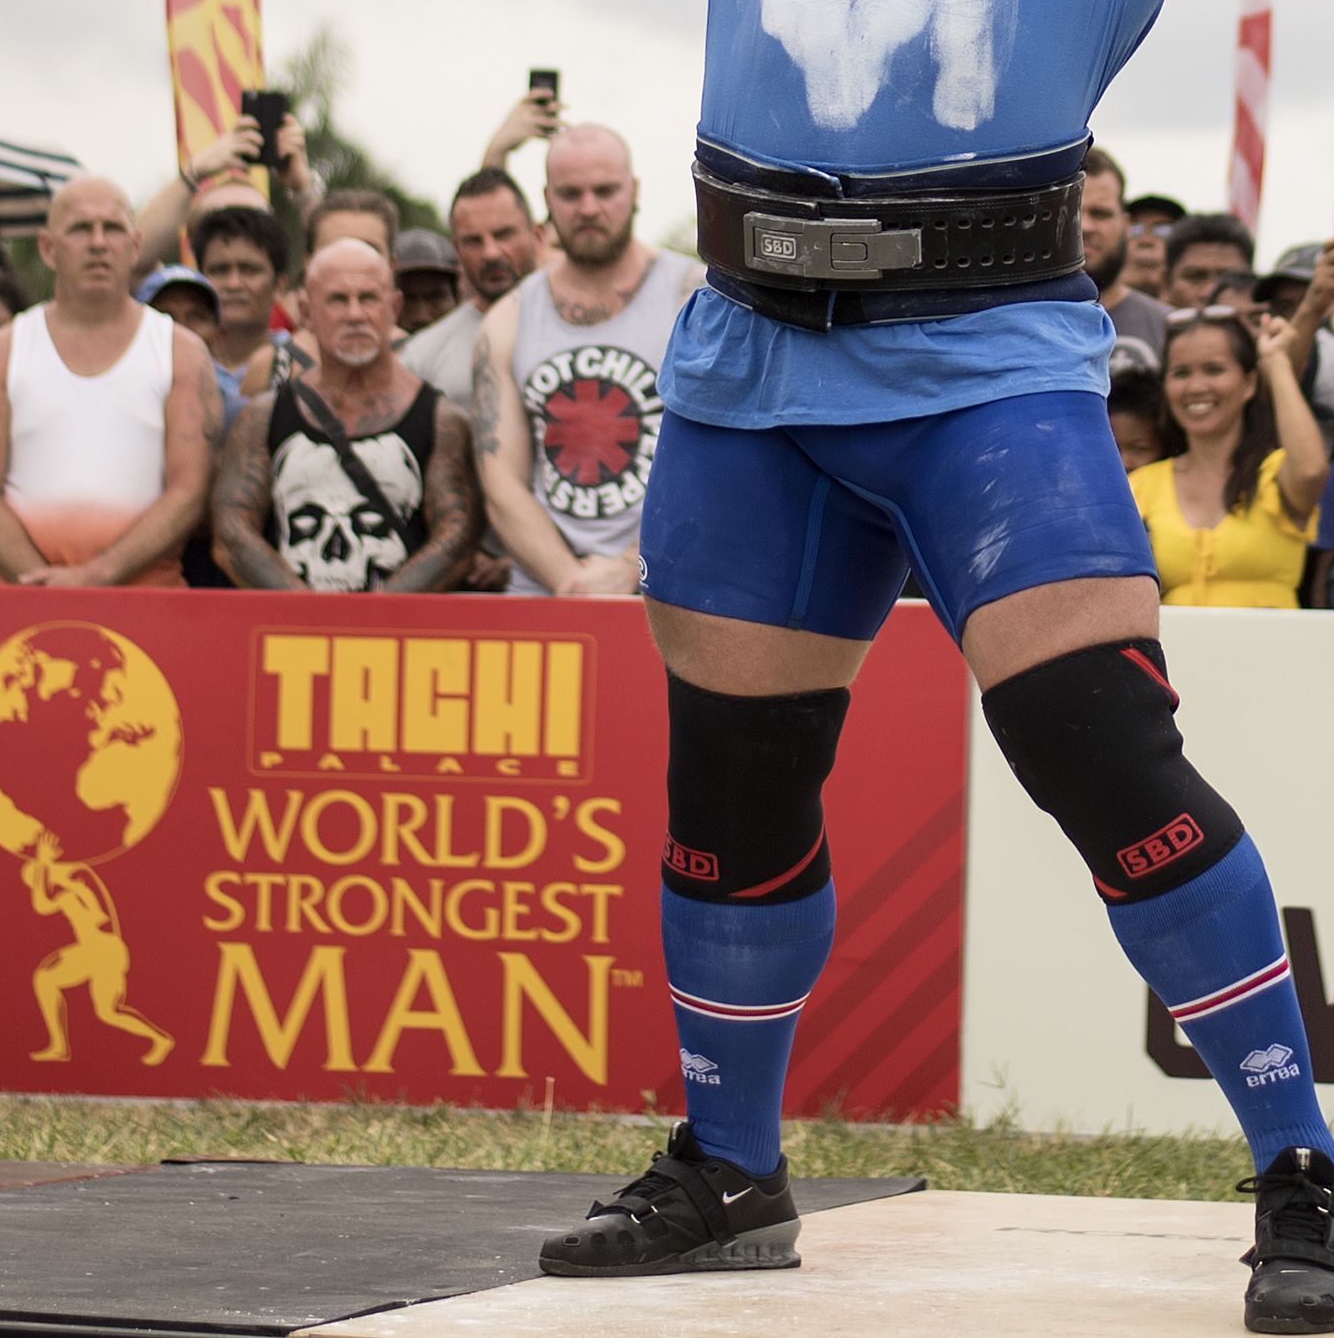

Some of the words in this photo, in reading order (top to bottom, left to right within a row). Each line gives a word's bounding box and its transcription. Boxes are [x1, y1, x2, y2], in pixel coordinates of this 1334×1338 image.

[764, 238, 794, 256] SBD
[261, 750, 579, 777] PALACE
[209, 788, 627, 873] WORLD'S
[1126, 821, 1195, 872] SBD
[664, 838, 712, 876] SBD
[203, 873, 623, 943] STRONGEST
[200, 942, 614, 1086] MAN
[682, 1070, 721, 1084] rrea
